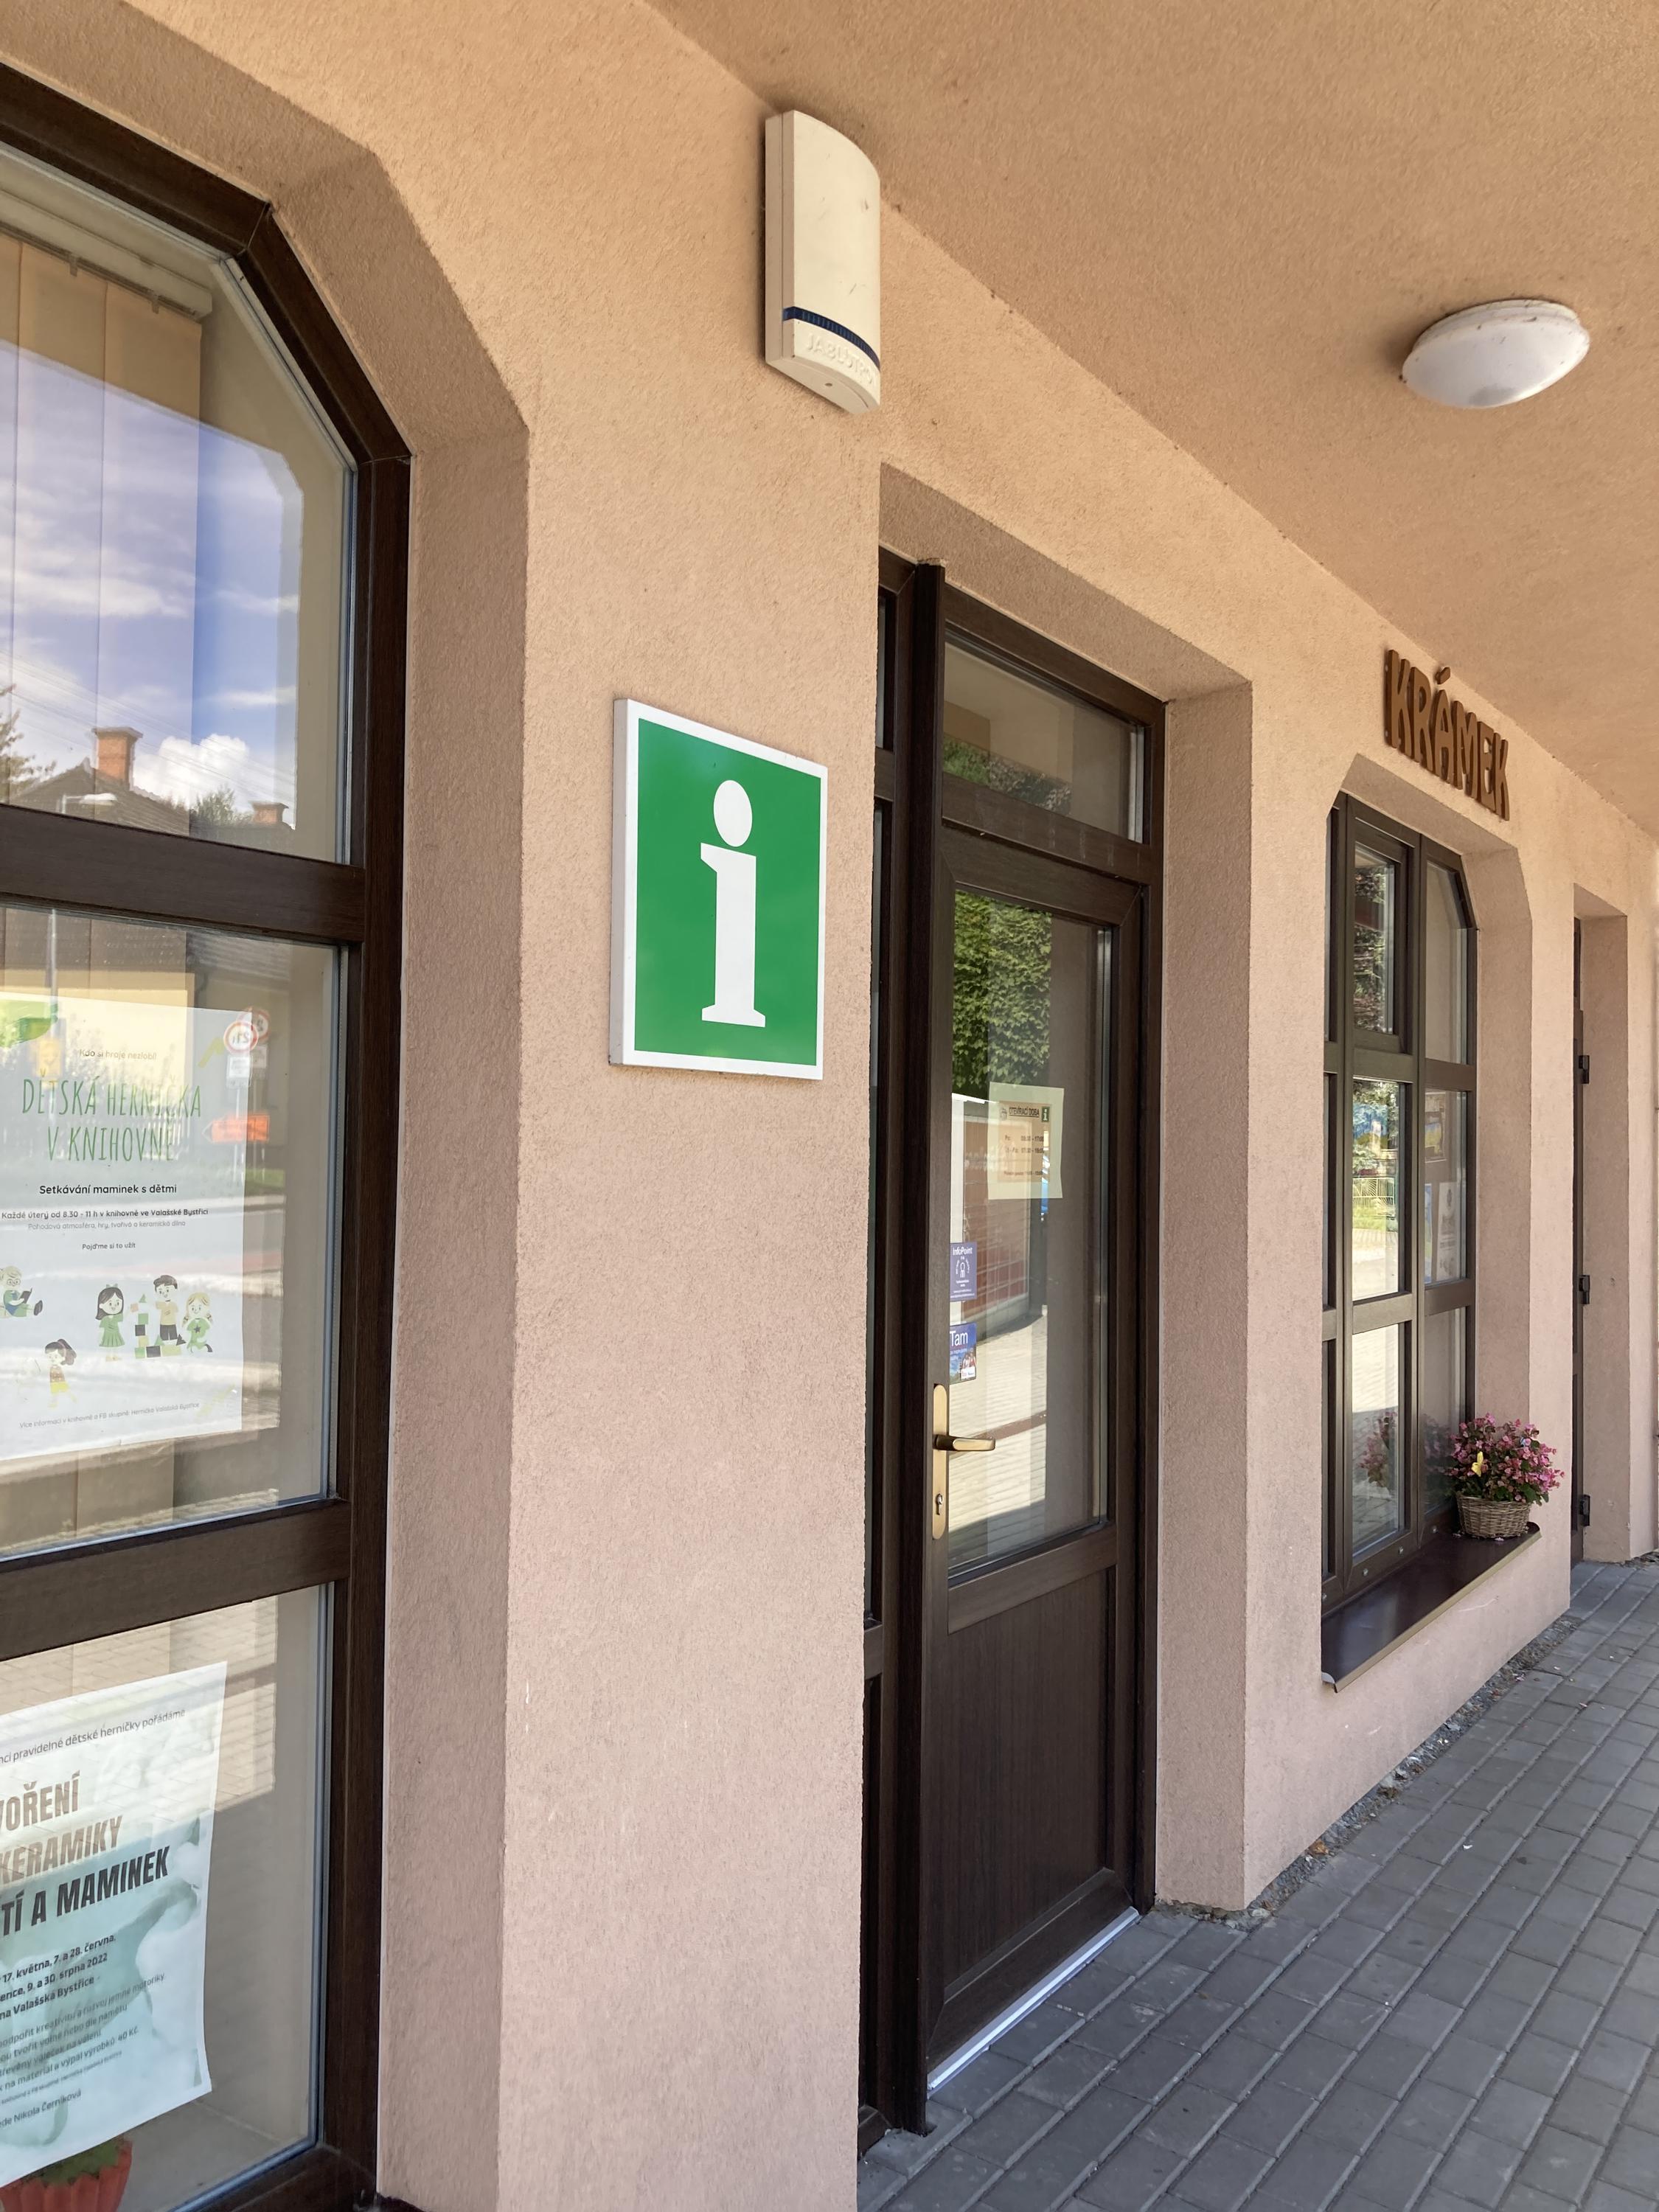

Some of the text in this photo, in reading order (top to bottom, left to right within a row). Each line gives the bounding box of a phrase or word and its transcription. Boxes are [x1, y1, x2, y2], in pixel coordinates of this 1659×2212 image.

[1385, 649, 1509, 821] KRÁMEK
[700, 780, 765, 1027] i
[79, 1048, 95, 1057] Kdo
[105, 1050, 125, 1060] hraje
[22, 1068, 201, 1118] DĚTSKÁ HERNIČKA
[48, 1116, 174, 1162] V KNIHOVNĚ
[39, 1183, 177, 1194] Setkávání maminek s dětmi
[105, 1209, 139, 1217] knihovně
[150, 1208, 182, 1217] Valašské
[183, 1208, 209, 1217] Bystřici
[952, 1246, 973, 1256] InfoPoint
[950, 1330, 968, 1346] Tam
[13, 1736, 63, 1763] pravidelné
[65, 1729, 99, 1747] dětské
[100, 1722, 141, 1737] herničky
[142, 1708, 186, 1729] pořádáme
[1, 1845, 170, 1936] TÍ A MAMINEK
[63, 1952, 69, 1961] a
[37, 1980, 43, 1989] a
[60, 1962, 86, 1979] srpna
[87, 1952, 108, 1969] 2022
[0, 2009, 11, 2020] na
[57, 1976, 94, 1997] Bystřice
[4, 2079, 15, 2090] na
[13, 2107, 40, 2123] Nikola
